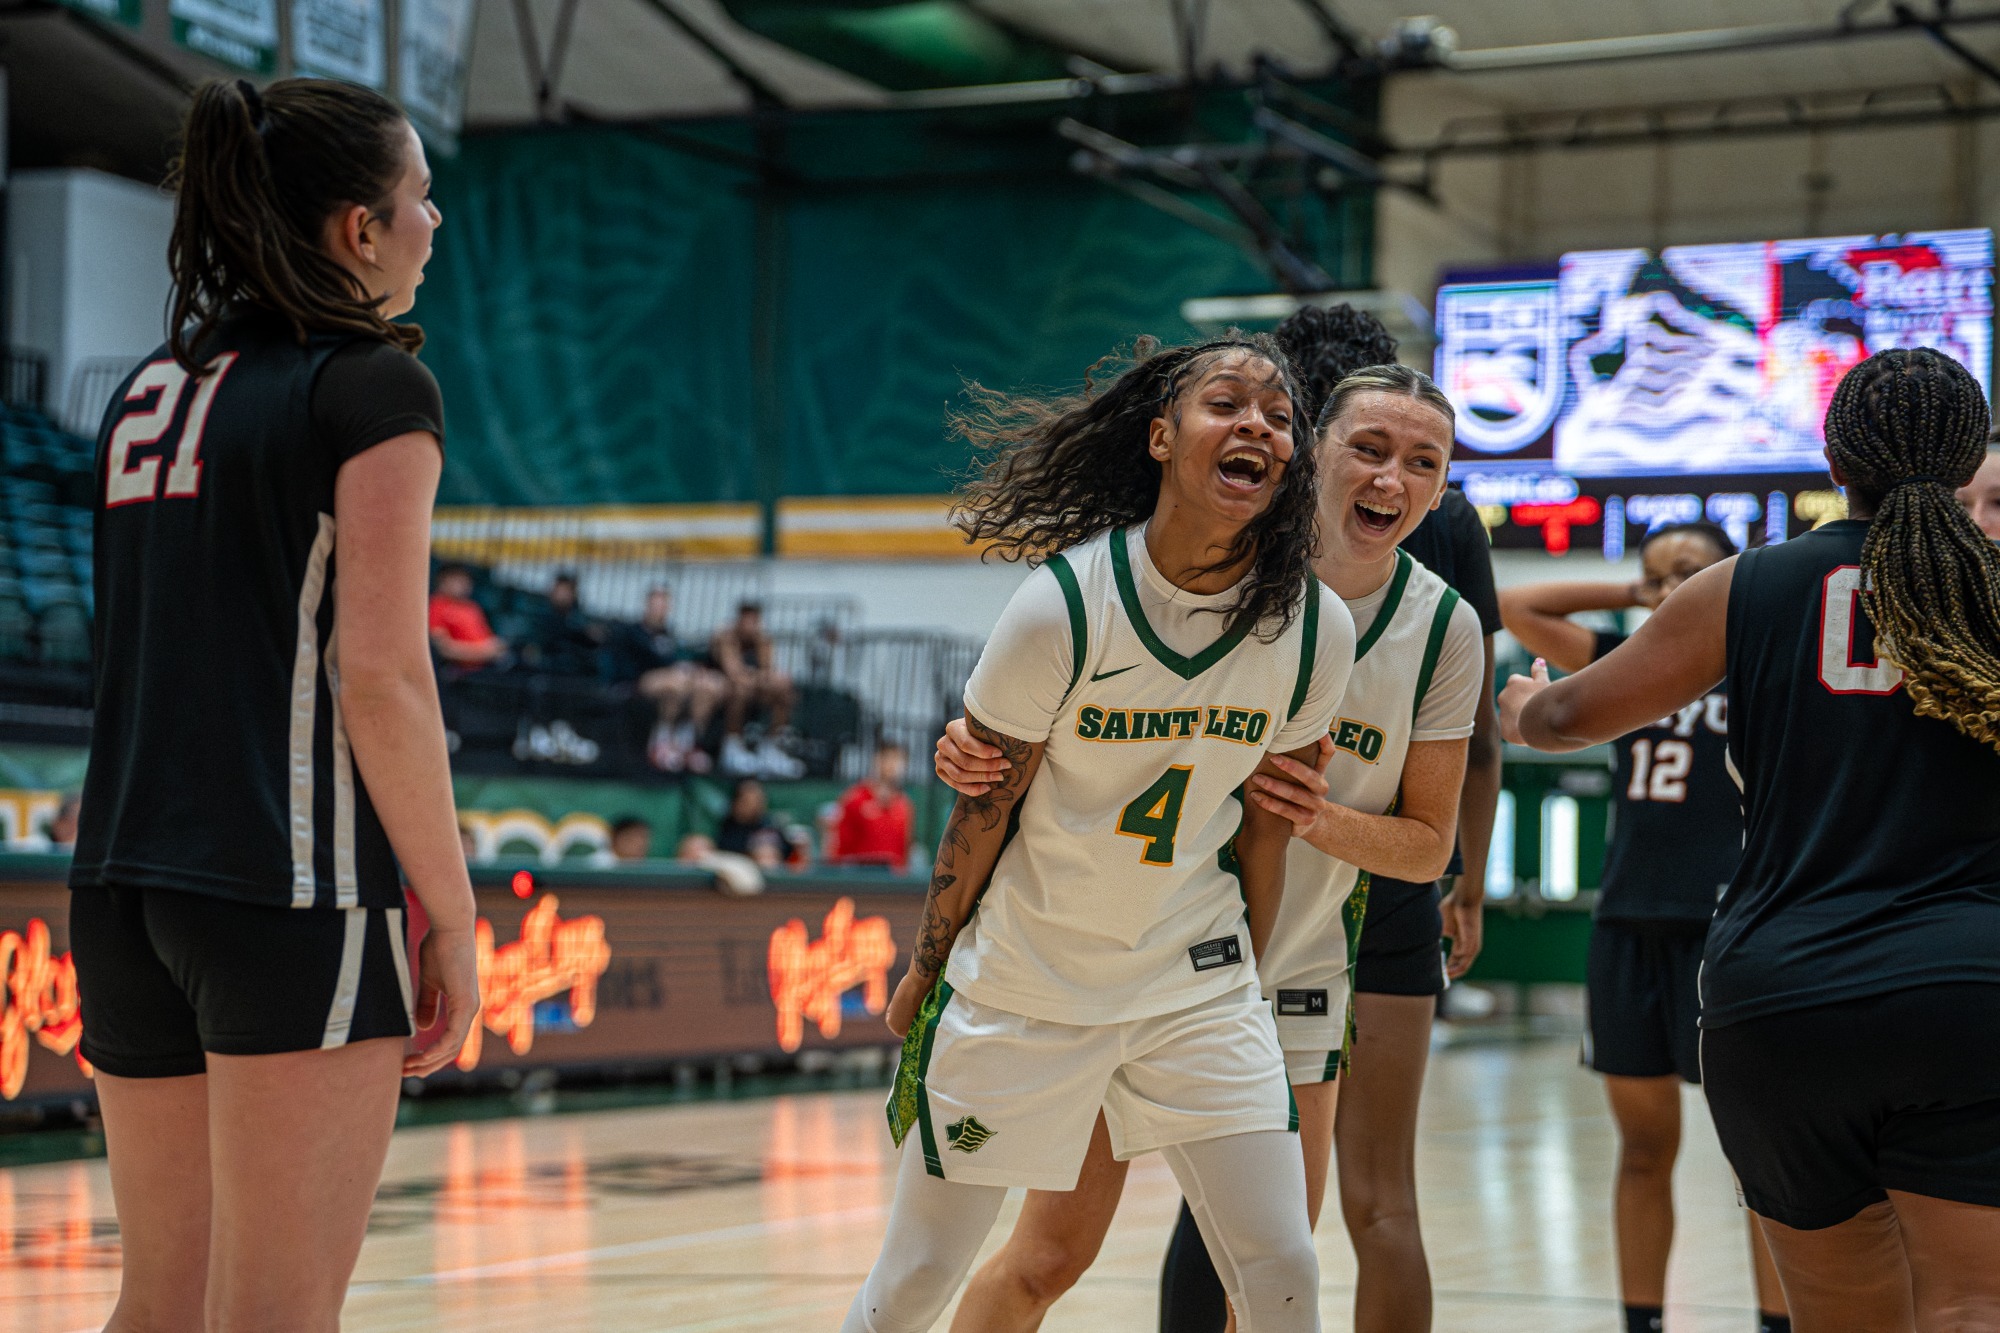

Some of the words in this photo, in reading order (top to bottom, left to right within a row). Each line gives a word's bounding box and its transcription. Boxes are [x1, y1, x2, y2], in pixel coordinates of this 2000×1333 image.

[106, 351, 240, 509] 21
[1076, 703, 1201, 742] SAINT
[1202, 705, 1271, 746] LEO
[1627, 737, 1694, 803] 12
[1115, 763, 1195, 867] 4
[1228, 944, 1237, 956] M
[1311, 997, 1322, 1008] M
